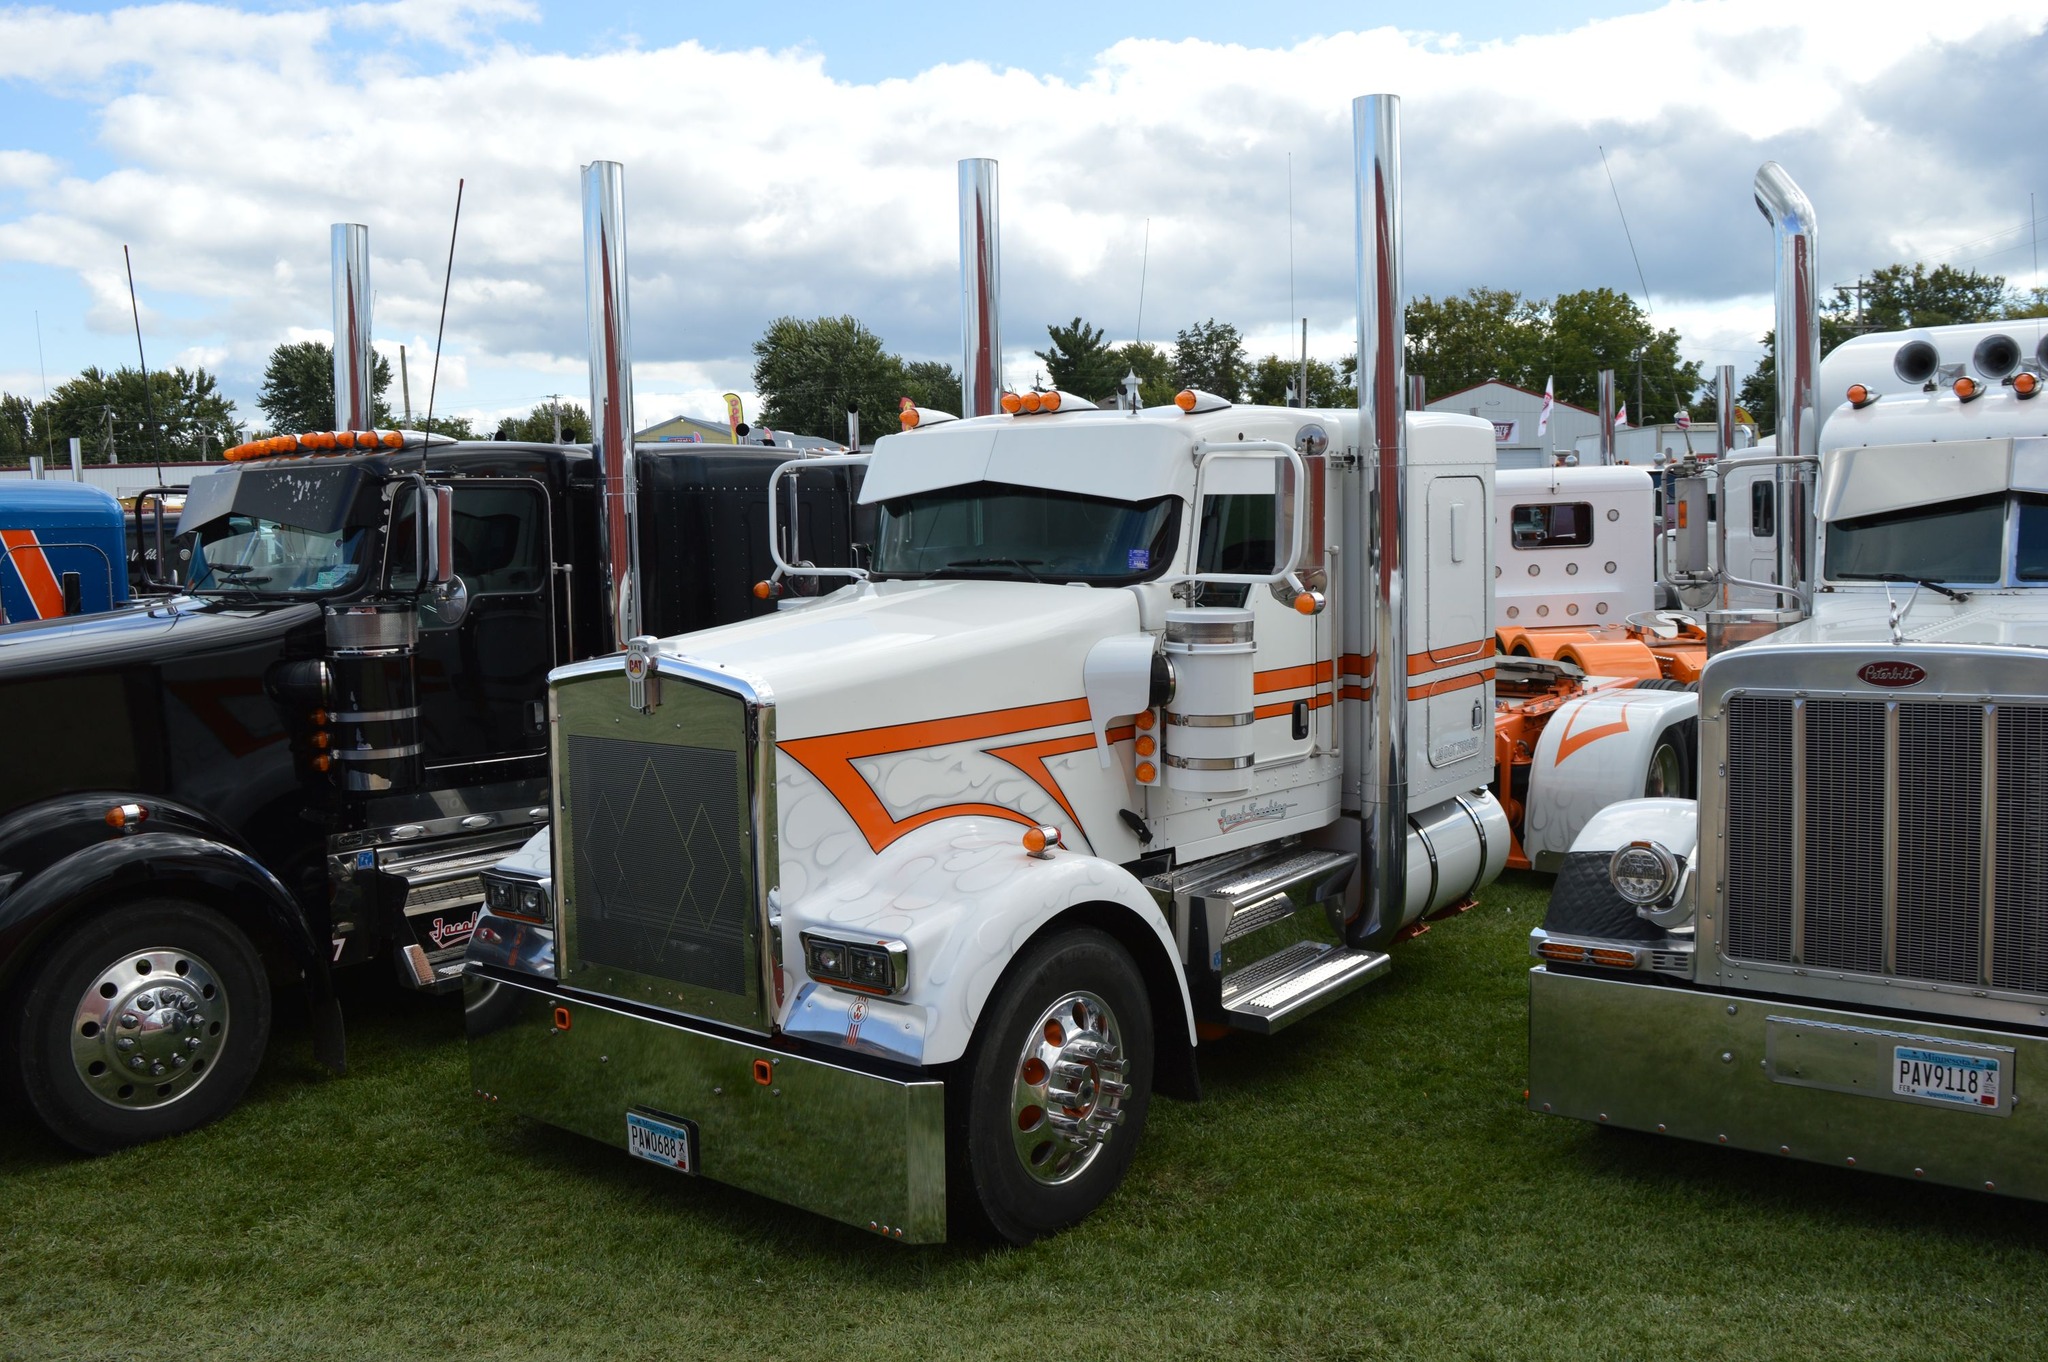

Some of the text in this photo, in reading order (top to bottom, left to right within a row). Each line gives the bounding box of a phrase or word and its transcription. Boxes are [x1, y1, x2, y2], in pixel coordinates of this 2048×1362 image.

[629, 659, 643, 673] CAT
[1865, 665, 1920, 681] Peterbilt
[1921, 1052, 1971, 1066] Minnesota
[1900, 1060, 1978, 1094] PAV9118
[1986, 1071, 1994, 1083] X
[1899, 1084, 1911, 1092] FEB
[1926, 1090, 1965, 1101] Apportioned
[632, 1125, 677, 1159] PAW0688
